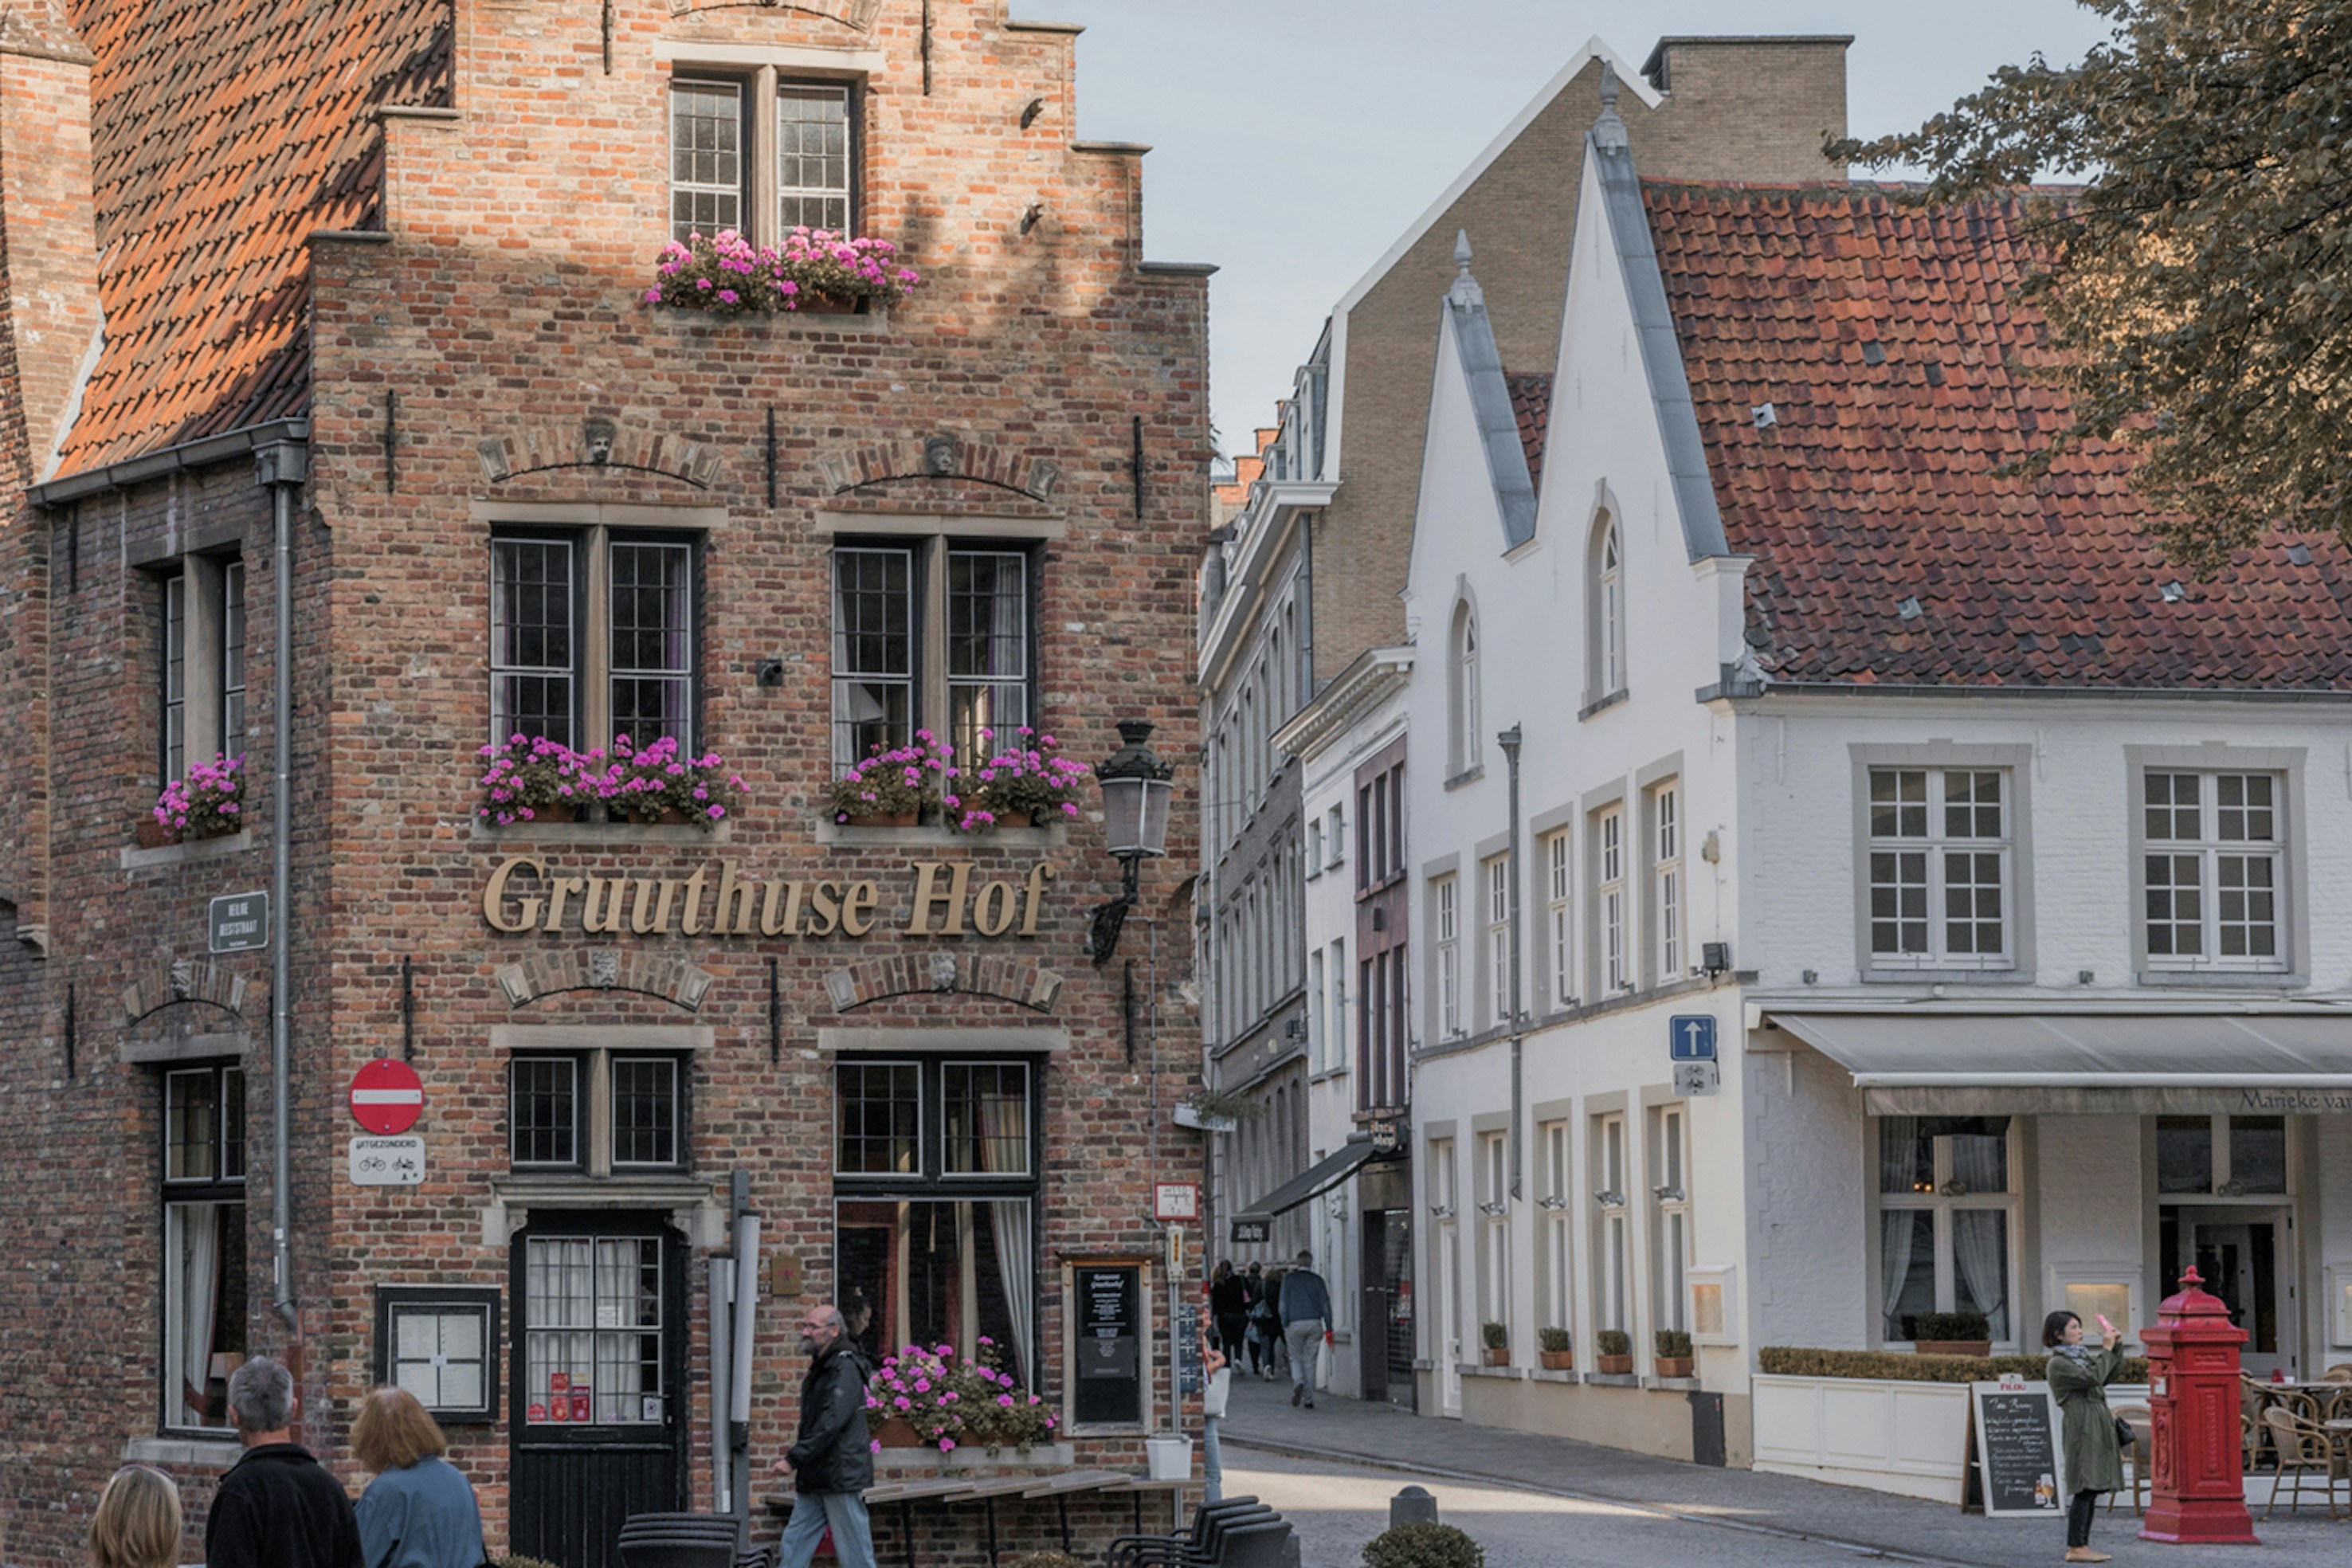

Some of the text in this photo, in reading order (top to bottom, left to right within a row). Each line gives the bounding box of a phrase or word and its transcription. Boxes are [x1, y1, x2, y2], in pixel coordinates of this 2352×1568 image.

[483, 857, 1056, 938] Gruuthuse Hof
[2239, 1089, 2319, 1112] Marieke
[355, 1139, 417, 1149] UITGEZONDERD
